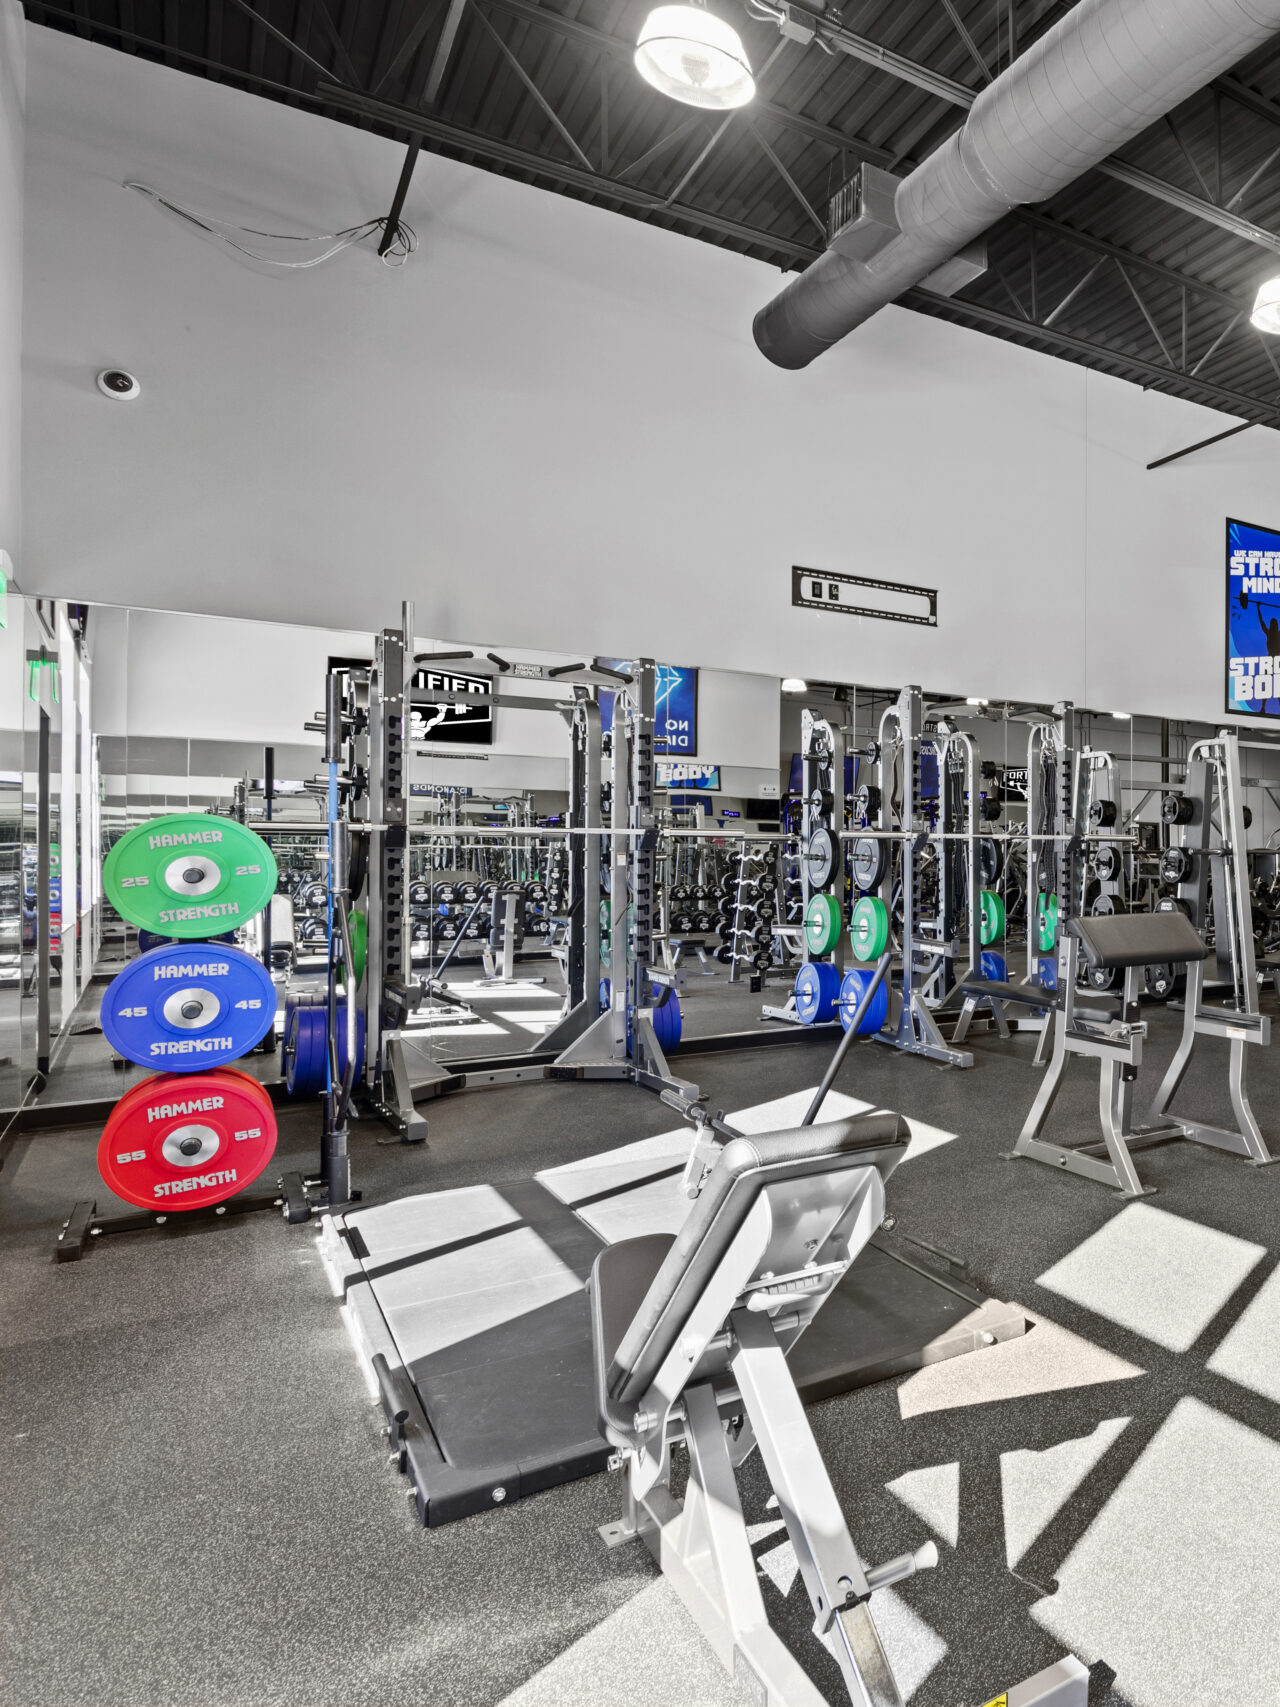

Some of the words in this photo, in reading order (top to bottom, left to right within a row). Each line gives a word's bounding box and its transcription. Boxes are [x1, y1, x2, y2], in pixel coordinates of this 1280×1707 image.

[149, 831, 223, 851] HAMMER
[121, 876, 149, 888] 25
[235, 864, 261, 876] 25
[159, 902, 239, 923] STRENGTH
[153, 963, 229, 981] HAMMER
[118, 1007, 148, 1018] 45
[234, 999, 261, 1010] 45
[150, 1036, 233, 1056] STRENGTH
[147, 1096, 224, 1123] HAMMER
[116, 1150, 146, 1164] 55
[234, 1128, 261, 1141] 55
[153, 1169, 237, 1198] STRENGTH
